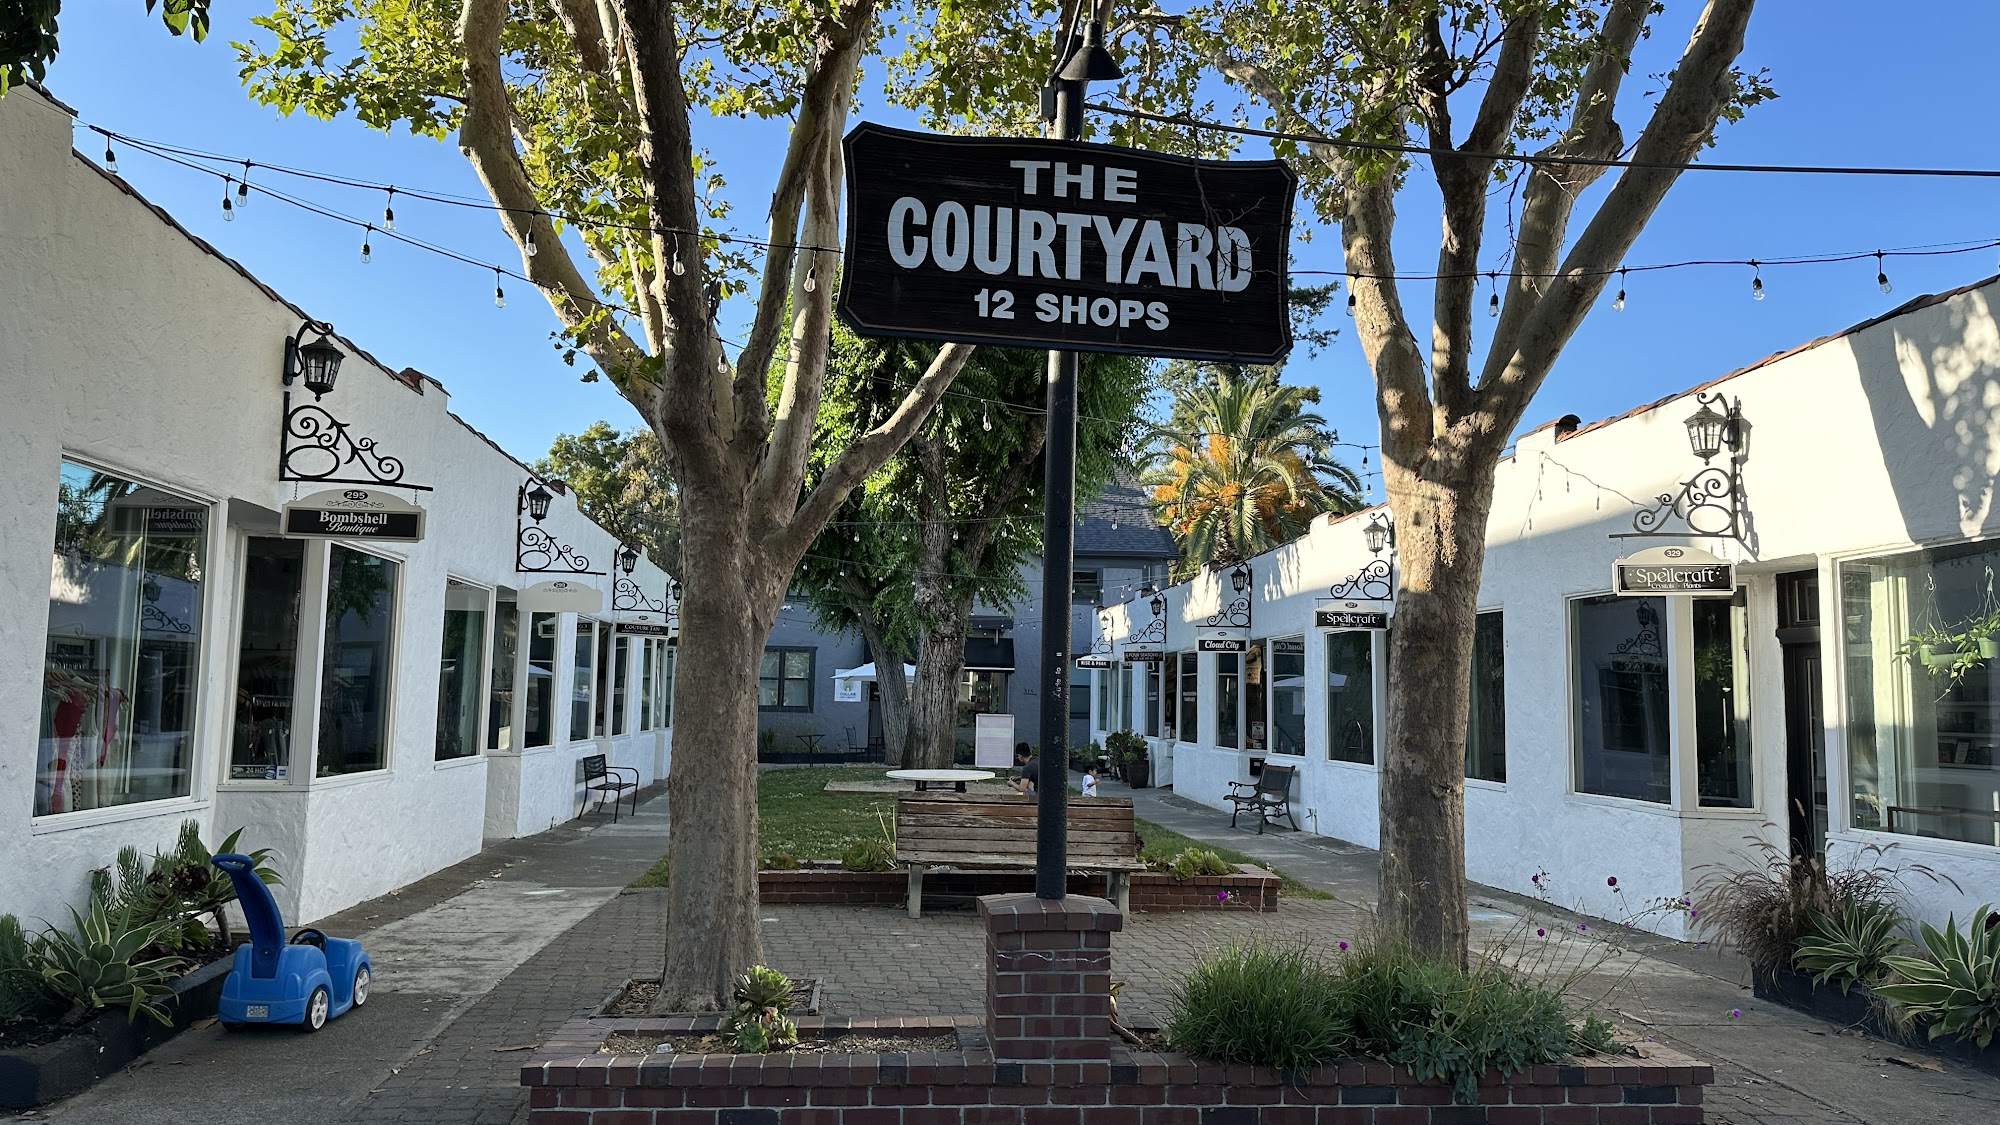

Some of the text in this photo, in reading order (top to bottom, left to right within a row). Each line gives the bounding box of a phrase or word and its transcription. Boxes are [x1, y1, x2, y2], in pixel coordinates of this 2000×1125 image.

[1010, 160, 1138, 203] THE
[887, 196, 1253, 293] COURTYARD
[973, 288, 1170, 331] 12 SHOPS
[346, 491, 365, 499] 295
[319, 511, 388, 525] Bombshell
[325, 522, 379, 535] Boutique
[1636, 567, 1715, 587] Spellcraft
[1326, 613, 1377, 625] Spellcraft
[1204, 641, 1239, 650] Cloud City
